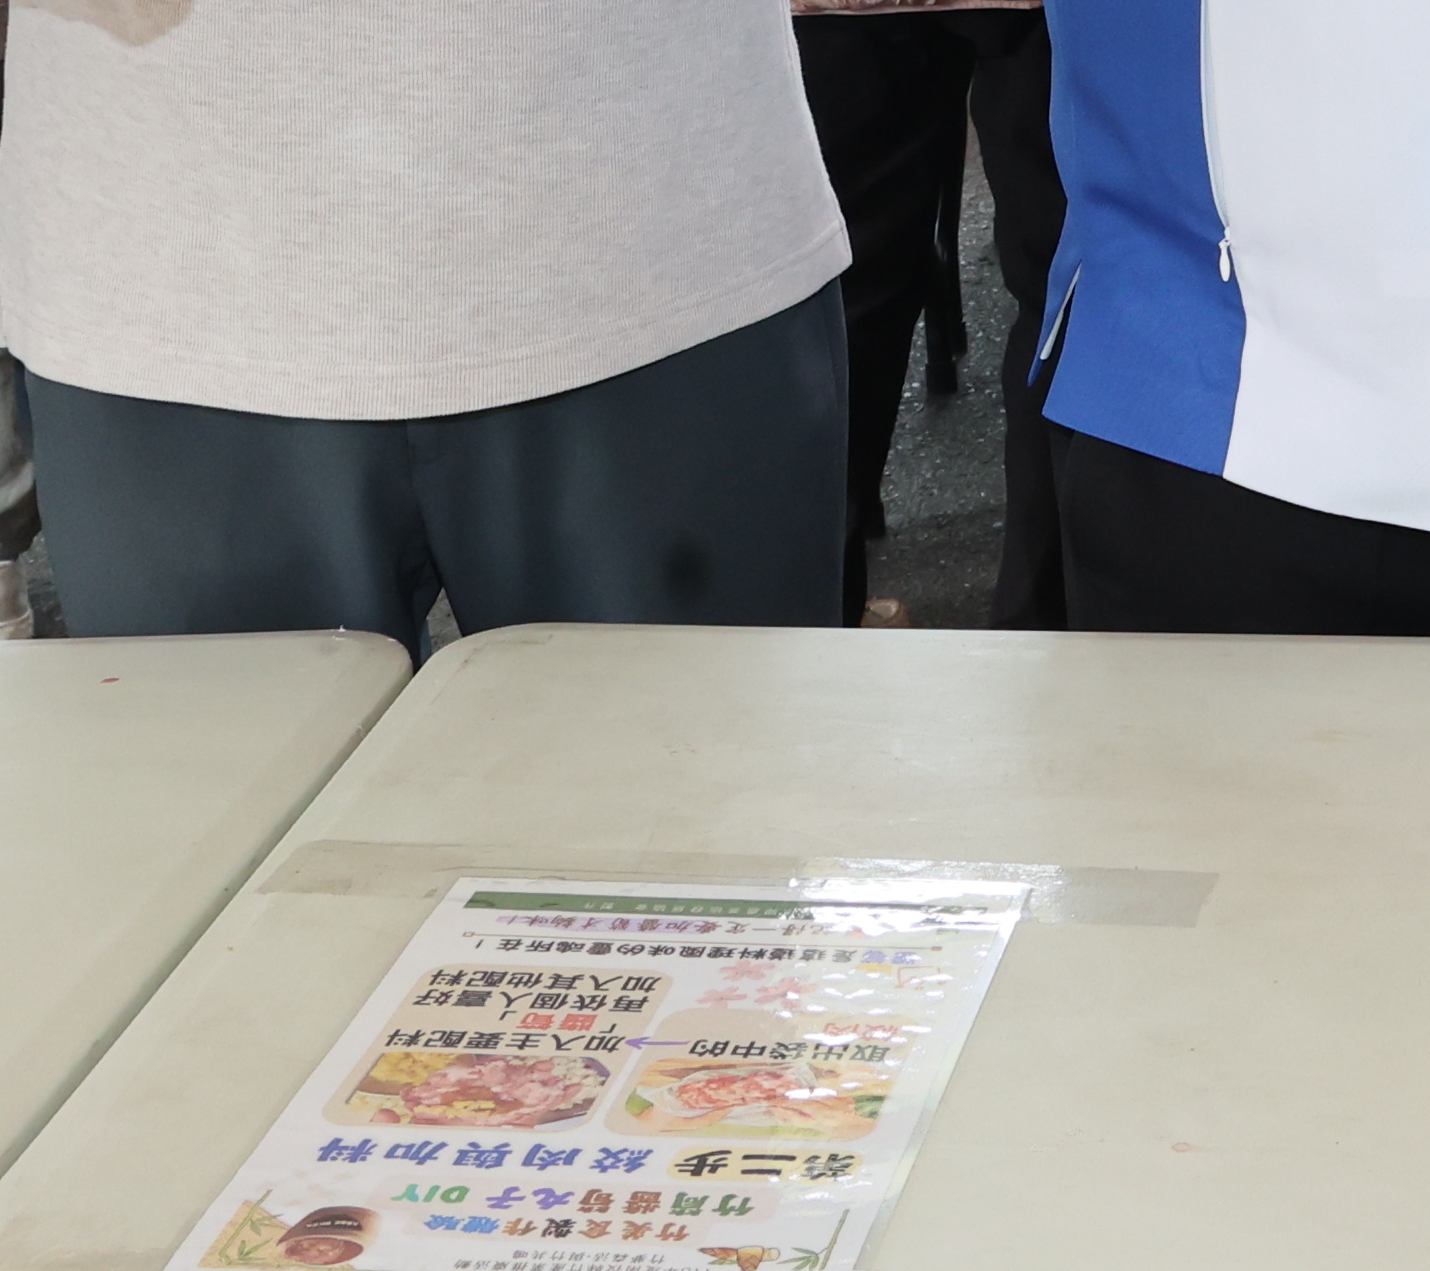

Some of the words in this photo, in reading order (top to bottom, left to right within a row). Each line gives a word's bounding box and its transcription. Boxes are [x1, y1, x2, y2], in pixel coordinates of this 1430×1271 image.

[428, 969, 663, 994] 加入其他配料
[412, 987, 651, 1014] 再依個人喜好
[386, 1027, 626, 1054] 加入主要配料
[688, 1039, 890, 1063] 取出袋中的
[317, 1137, 655, 1174] 絞肉與加料
[674, 1149, 856, 1180] 第二步
[391, 1182, 469, 1203] DIY
[485, 1185, 755, 1217] 竹筒醬筍丸子
[421, 1213, 691, 1242] 竹美食製作體驗
